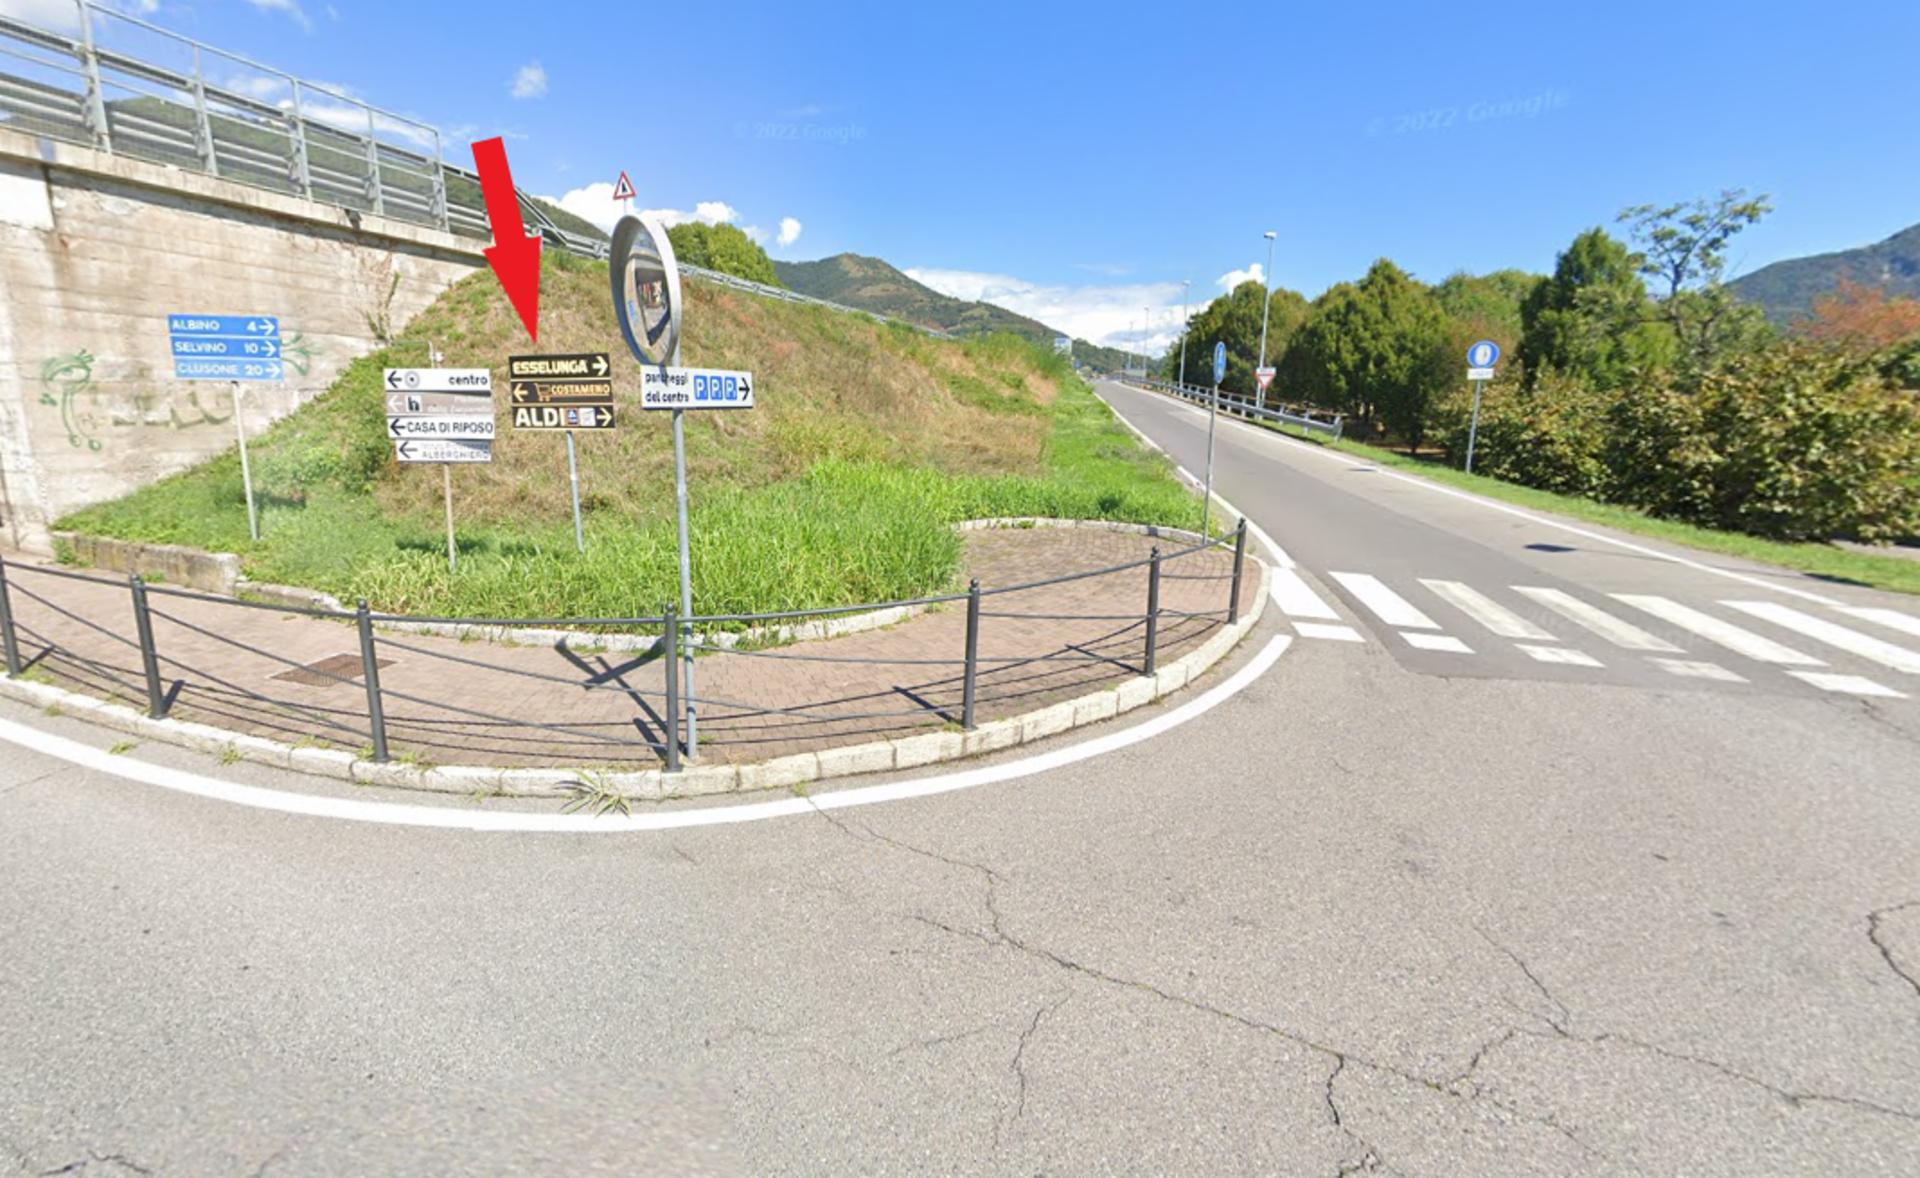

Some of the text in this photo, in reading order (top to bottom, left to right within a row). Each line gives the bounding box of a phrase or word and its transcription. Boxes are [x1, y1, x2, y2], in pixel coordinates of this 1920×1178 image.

[172, 319, 257, 332] ALBINO 4
[174, 341, 258, 354] SELVINO 10
[177, 363, 263, 376] CLUSONE 20
[512, 359, 589, 375] ESSELUNGA
[448, 374, 489, 385] centro
[645, 391, 660, 402] del
[515, 407, 566, 427] ALDI
[407, 422, 494, 434] CASA DI RIPOSO
